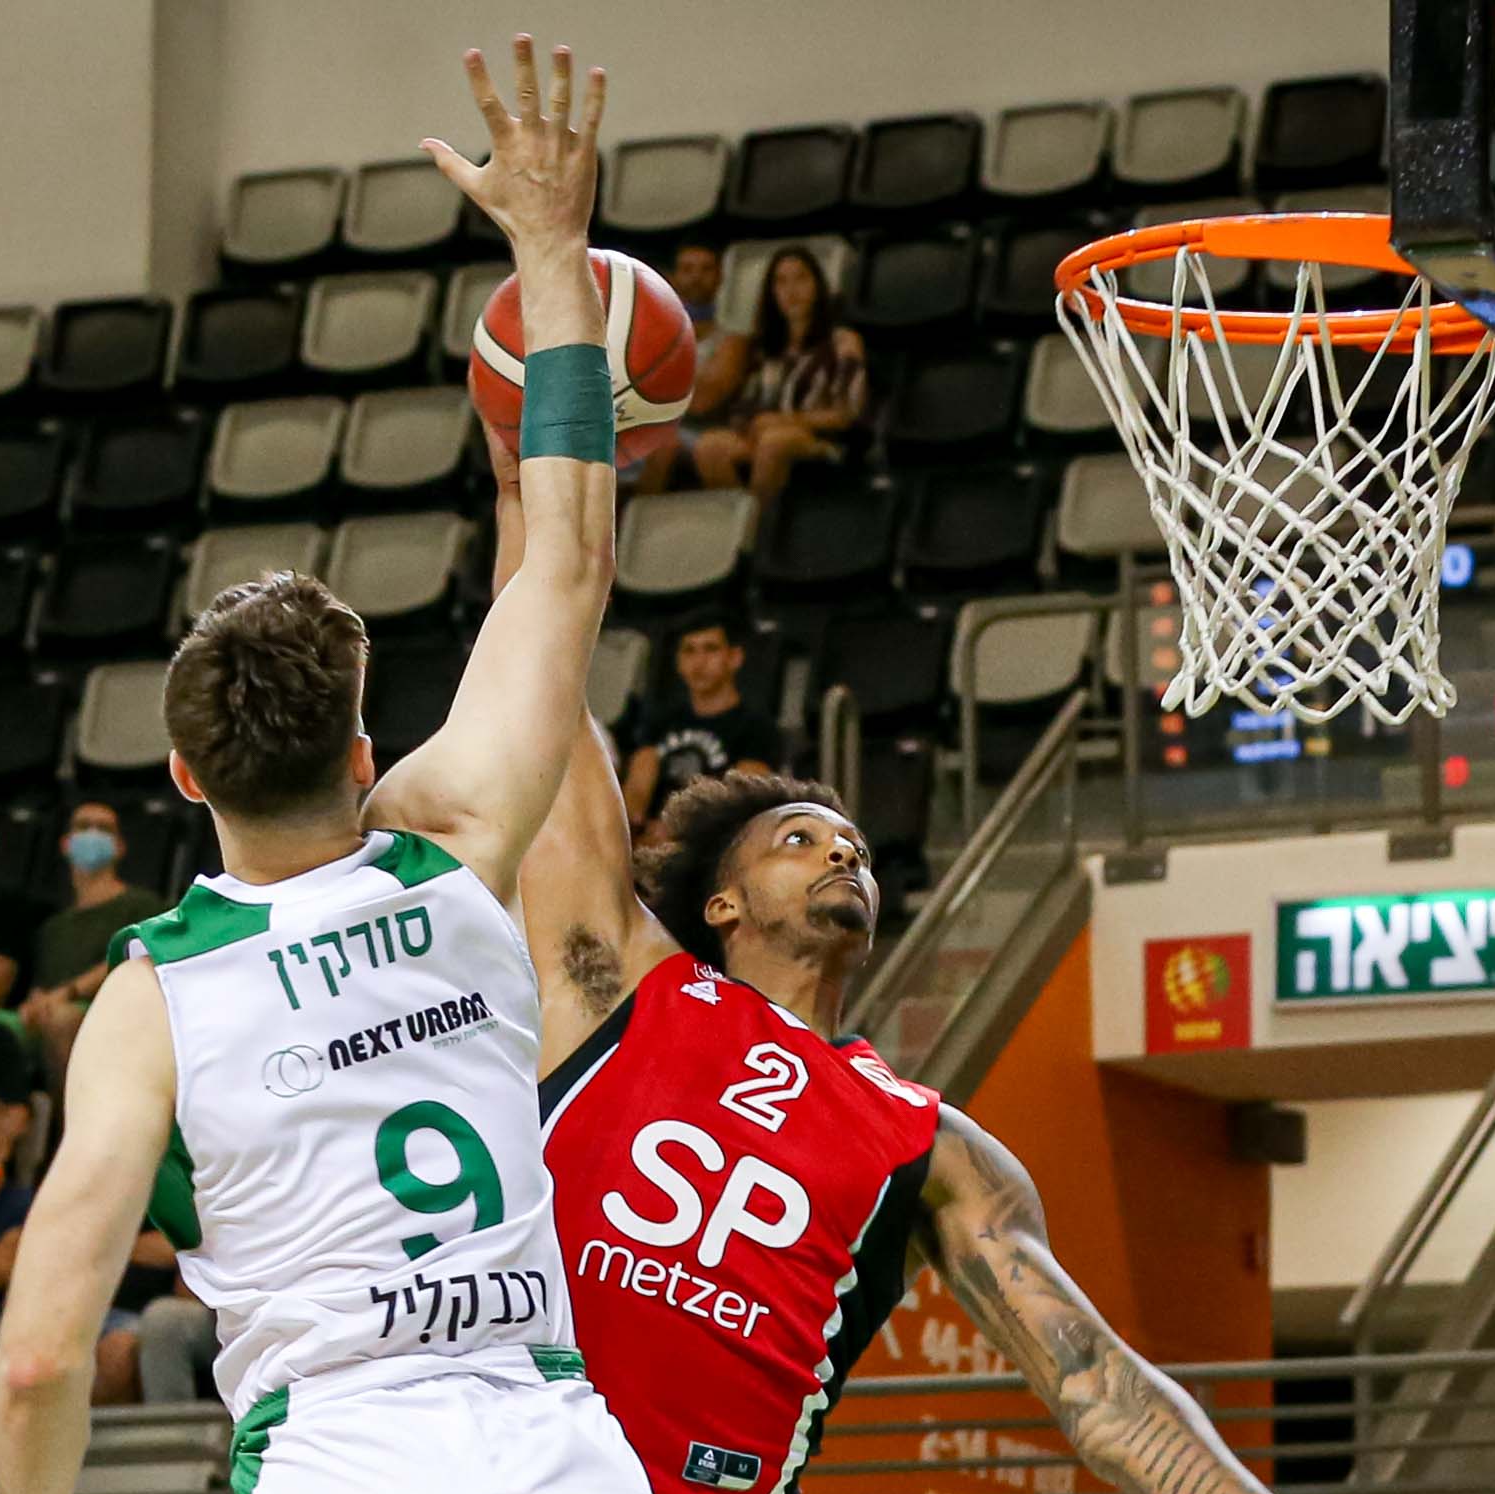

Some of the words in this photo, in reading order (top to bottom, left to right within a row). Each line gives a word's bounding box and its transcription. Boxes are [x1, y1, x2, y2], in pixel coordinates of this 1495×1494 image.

[267, 905, 433, 1011] סורקין
[328, 1018, 404, 1071] NEXT
[406, 992, 494, 1043] URBAN
[718, 1041, 810, 1133] 2
[375, 1100, 504, 1261] 9
[601, 1119, 811, 1268] SP
[369, 1272, 480, 1344] קליל
[577, 1239, 770, 1338] metzer
